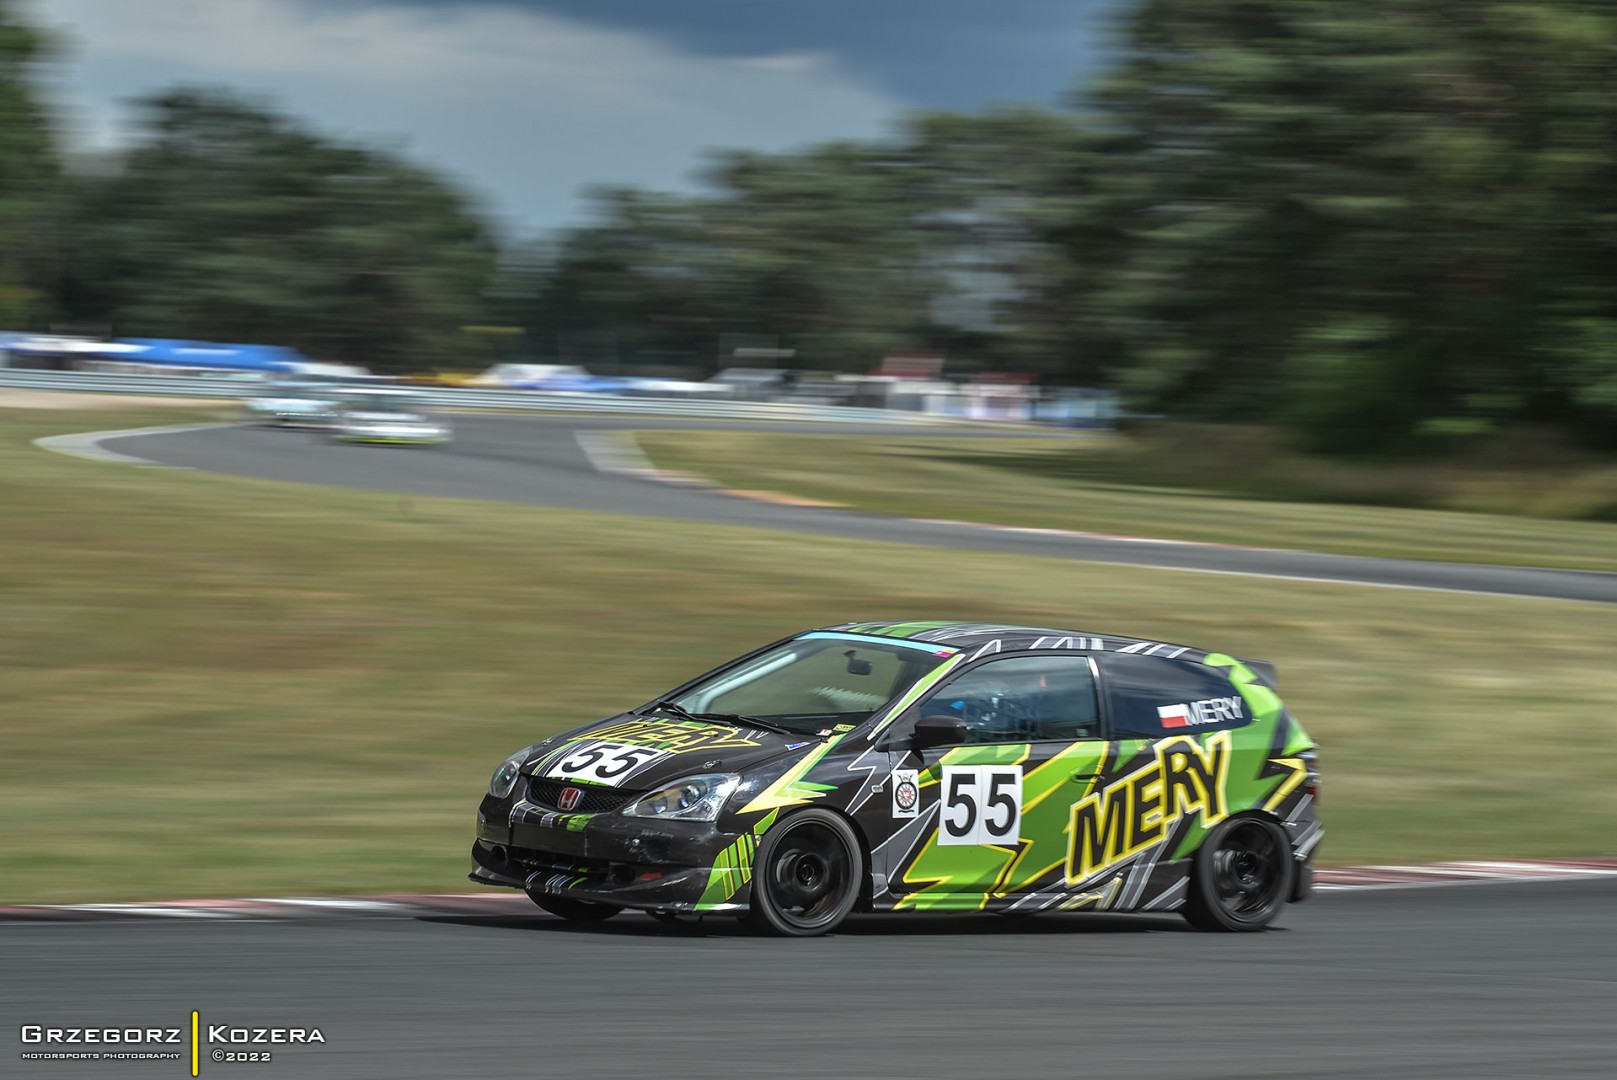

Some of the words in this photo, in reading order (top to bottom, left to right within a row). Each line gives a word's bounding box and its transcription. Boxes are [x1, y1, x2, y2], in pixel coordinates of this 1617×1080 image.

[1184, 695, 1244, 726] MERY
[561, 744, 659, 778] 55
[944, 773, 1016, 837] 55
[1066, 731, 1231, 887] MERY
